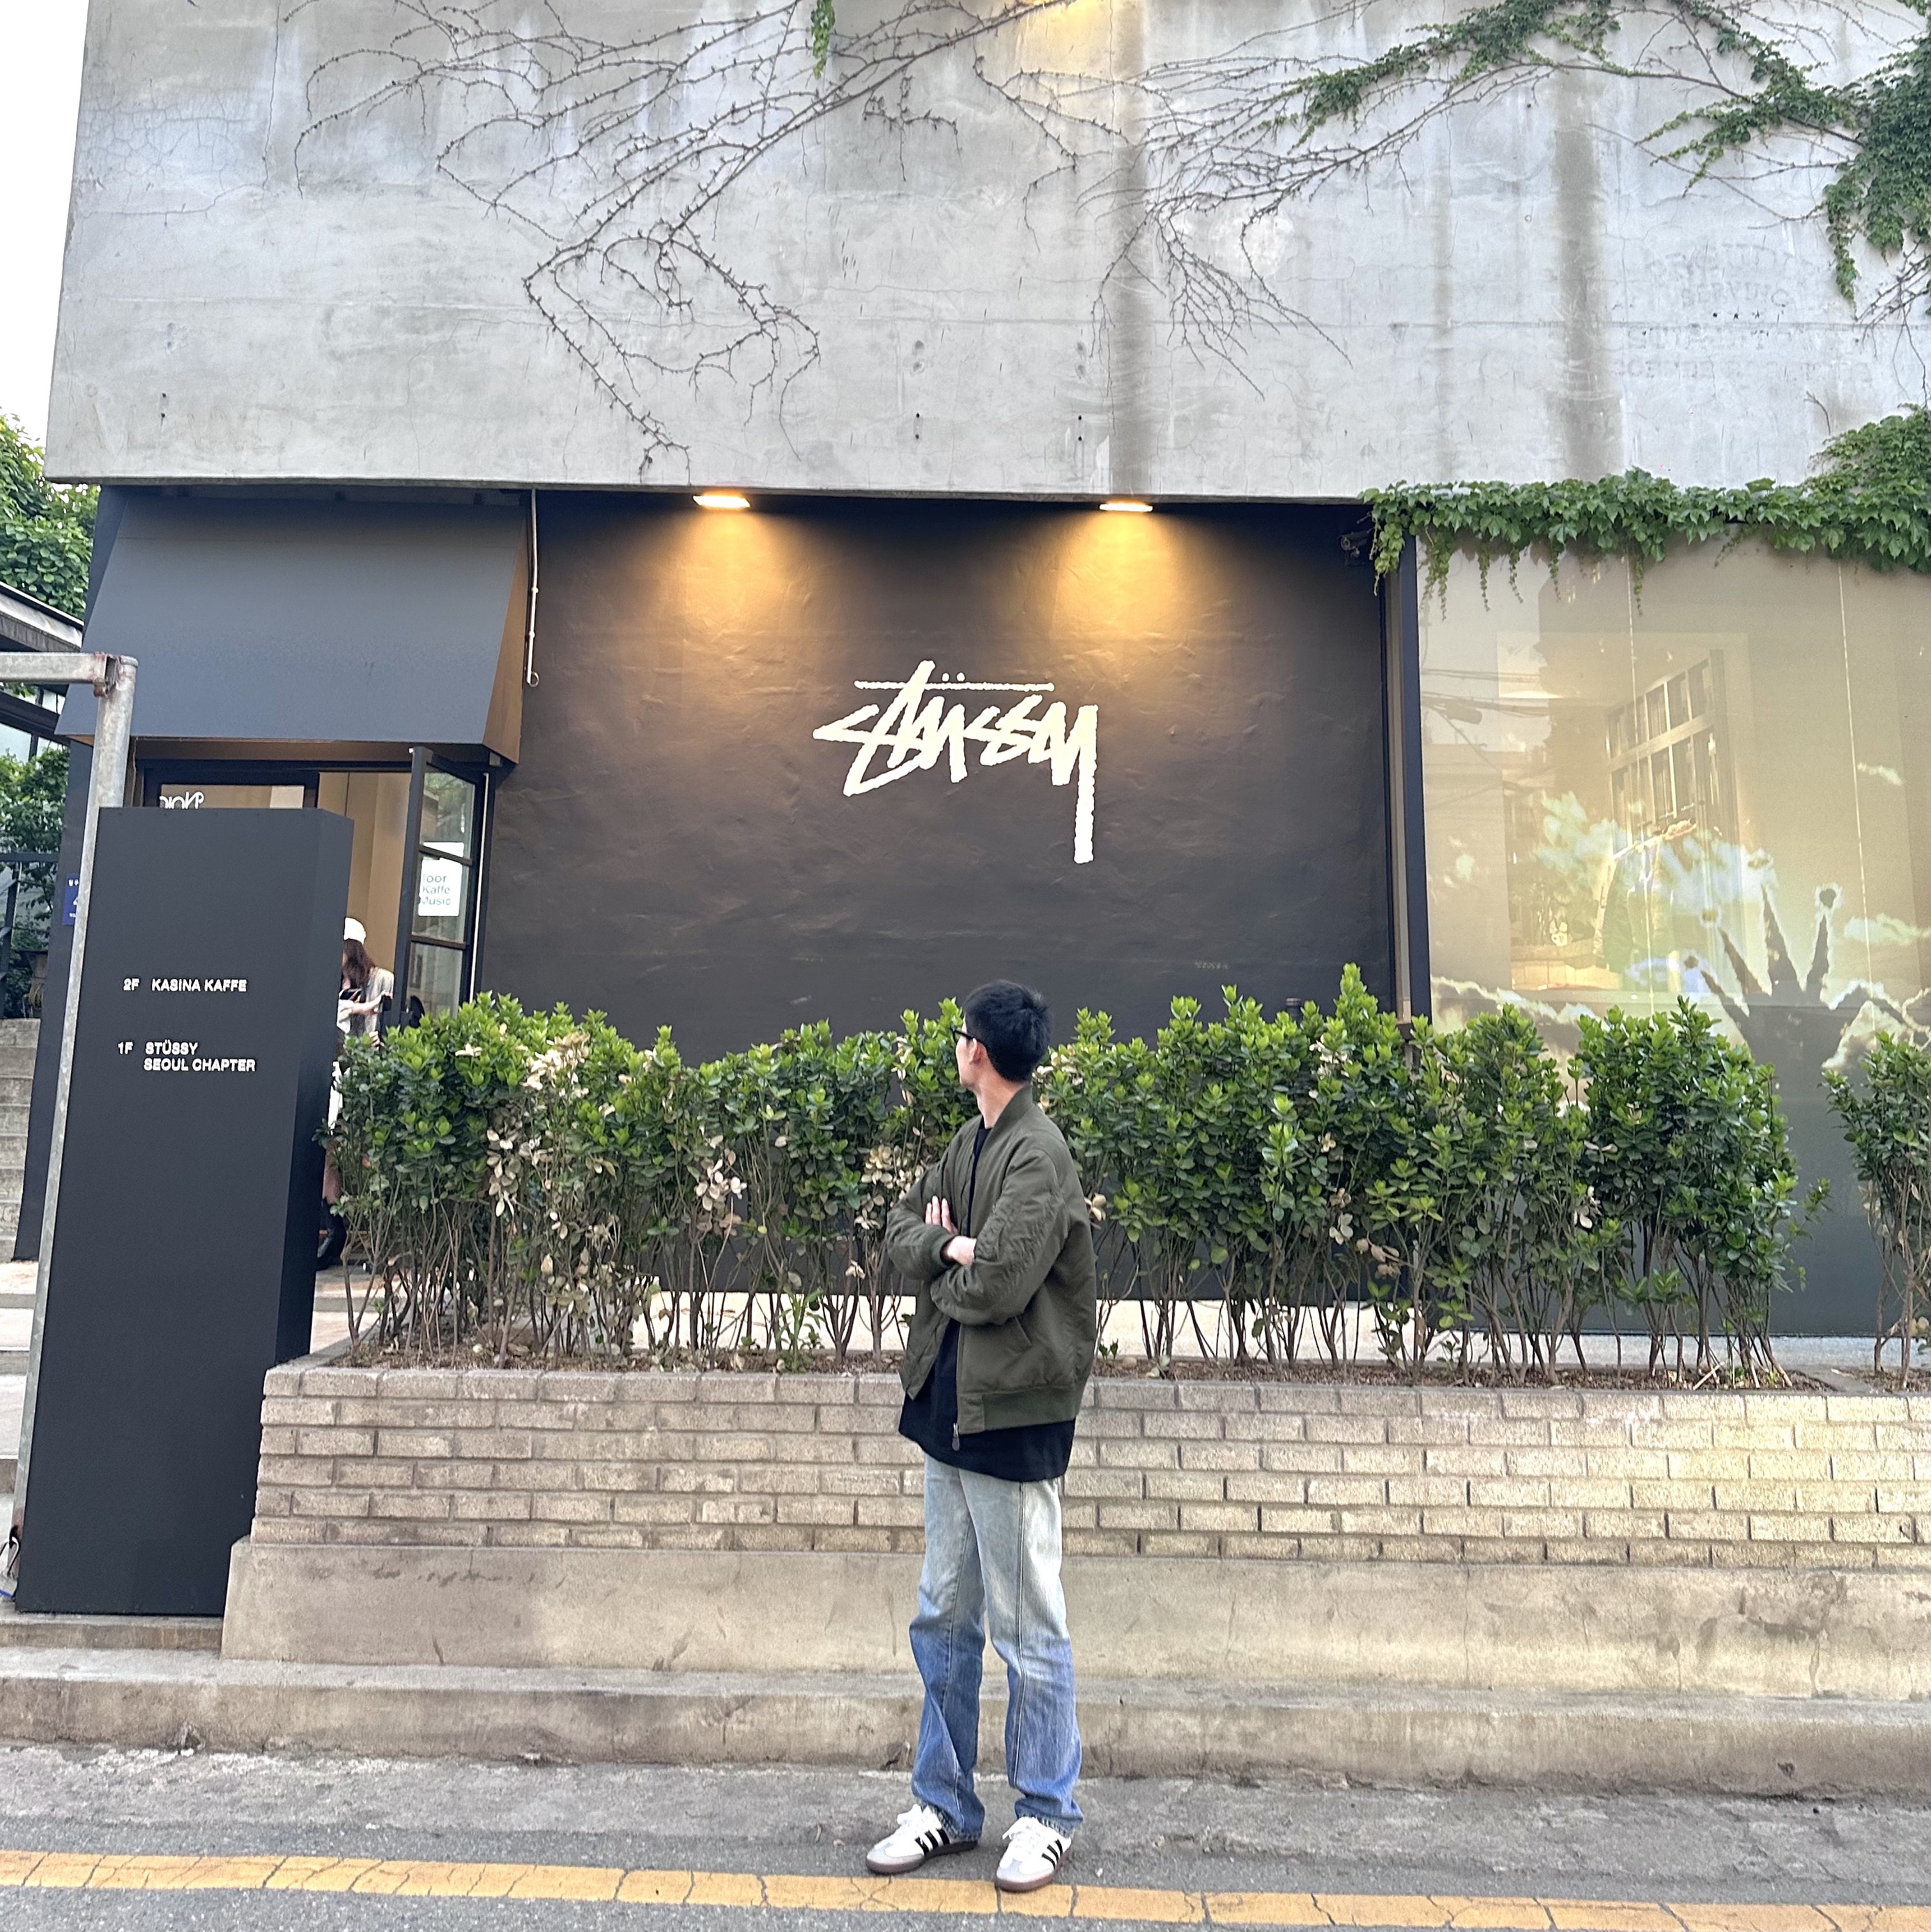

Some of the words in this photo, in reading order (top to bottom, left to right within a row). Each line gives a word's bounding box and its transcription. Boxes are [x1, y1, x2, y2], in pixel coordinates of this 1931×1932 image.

[123, 978, 139, 991] 2F
[151, 978, 201, 991] KASINA
[204, 979, 247, 992] KAFFE
[118, 1042, 133, 1055] 1F
[145, 1039, 198, 1055] STÜSSY
[144, 1058, 188, 1071] SEOUL
[192, 1058, 256, 1072] CHAPTER
